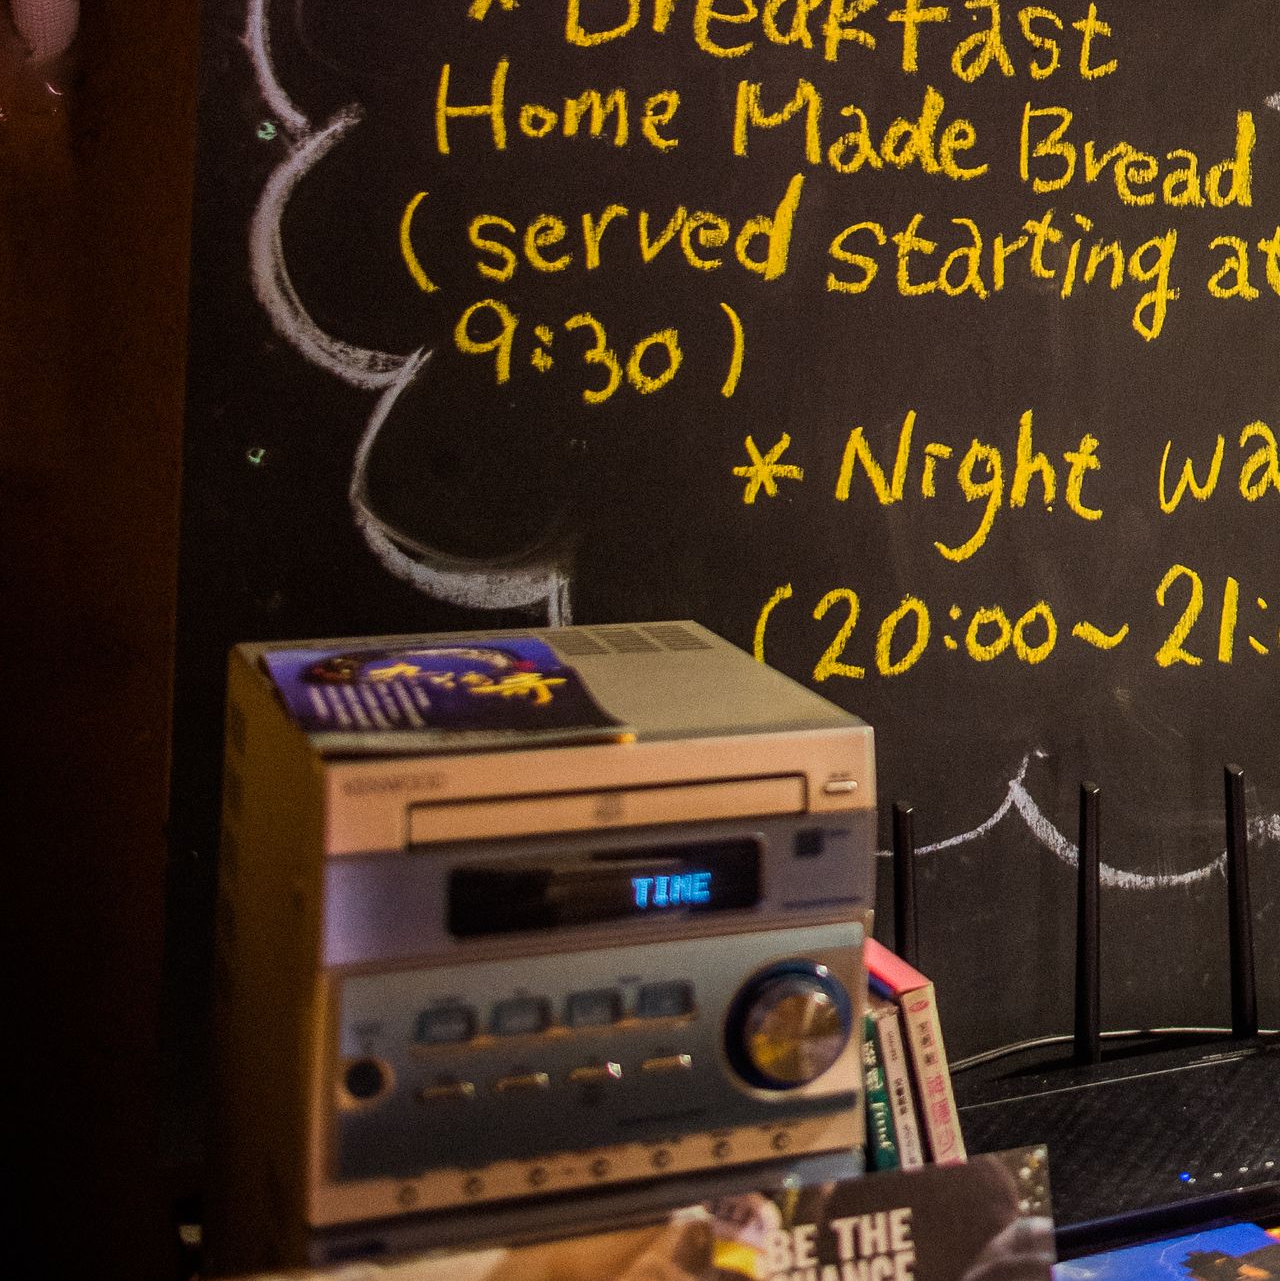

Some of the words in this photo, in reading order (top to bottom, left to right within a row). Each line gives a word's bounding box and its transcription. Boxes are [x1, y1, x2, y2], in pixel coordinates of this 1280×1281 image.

[435, 58, 681, 155] Home
[733, 78, 989, 180] Made
[1019, 107, 1256, 208] Bread
[827, 213, 1180, 341] starting
[834, 409, 1103, 563] Night
[632, 872, 712, 908] TIME
[764, 1223, 820, 1274] BE
[831, 1207, 916, 1260] THE
